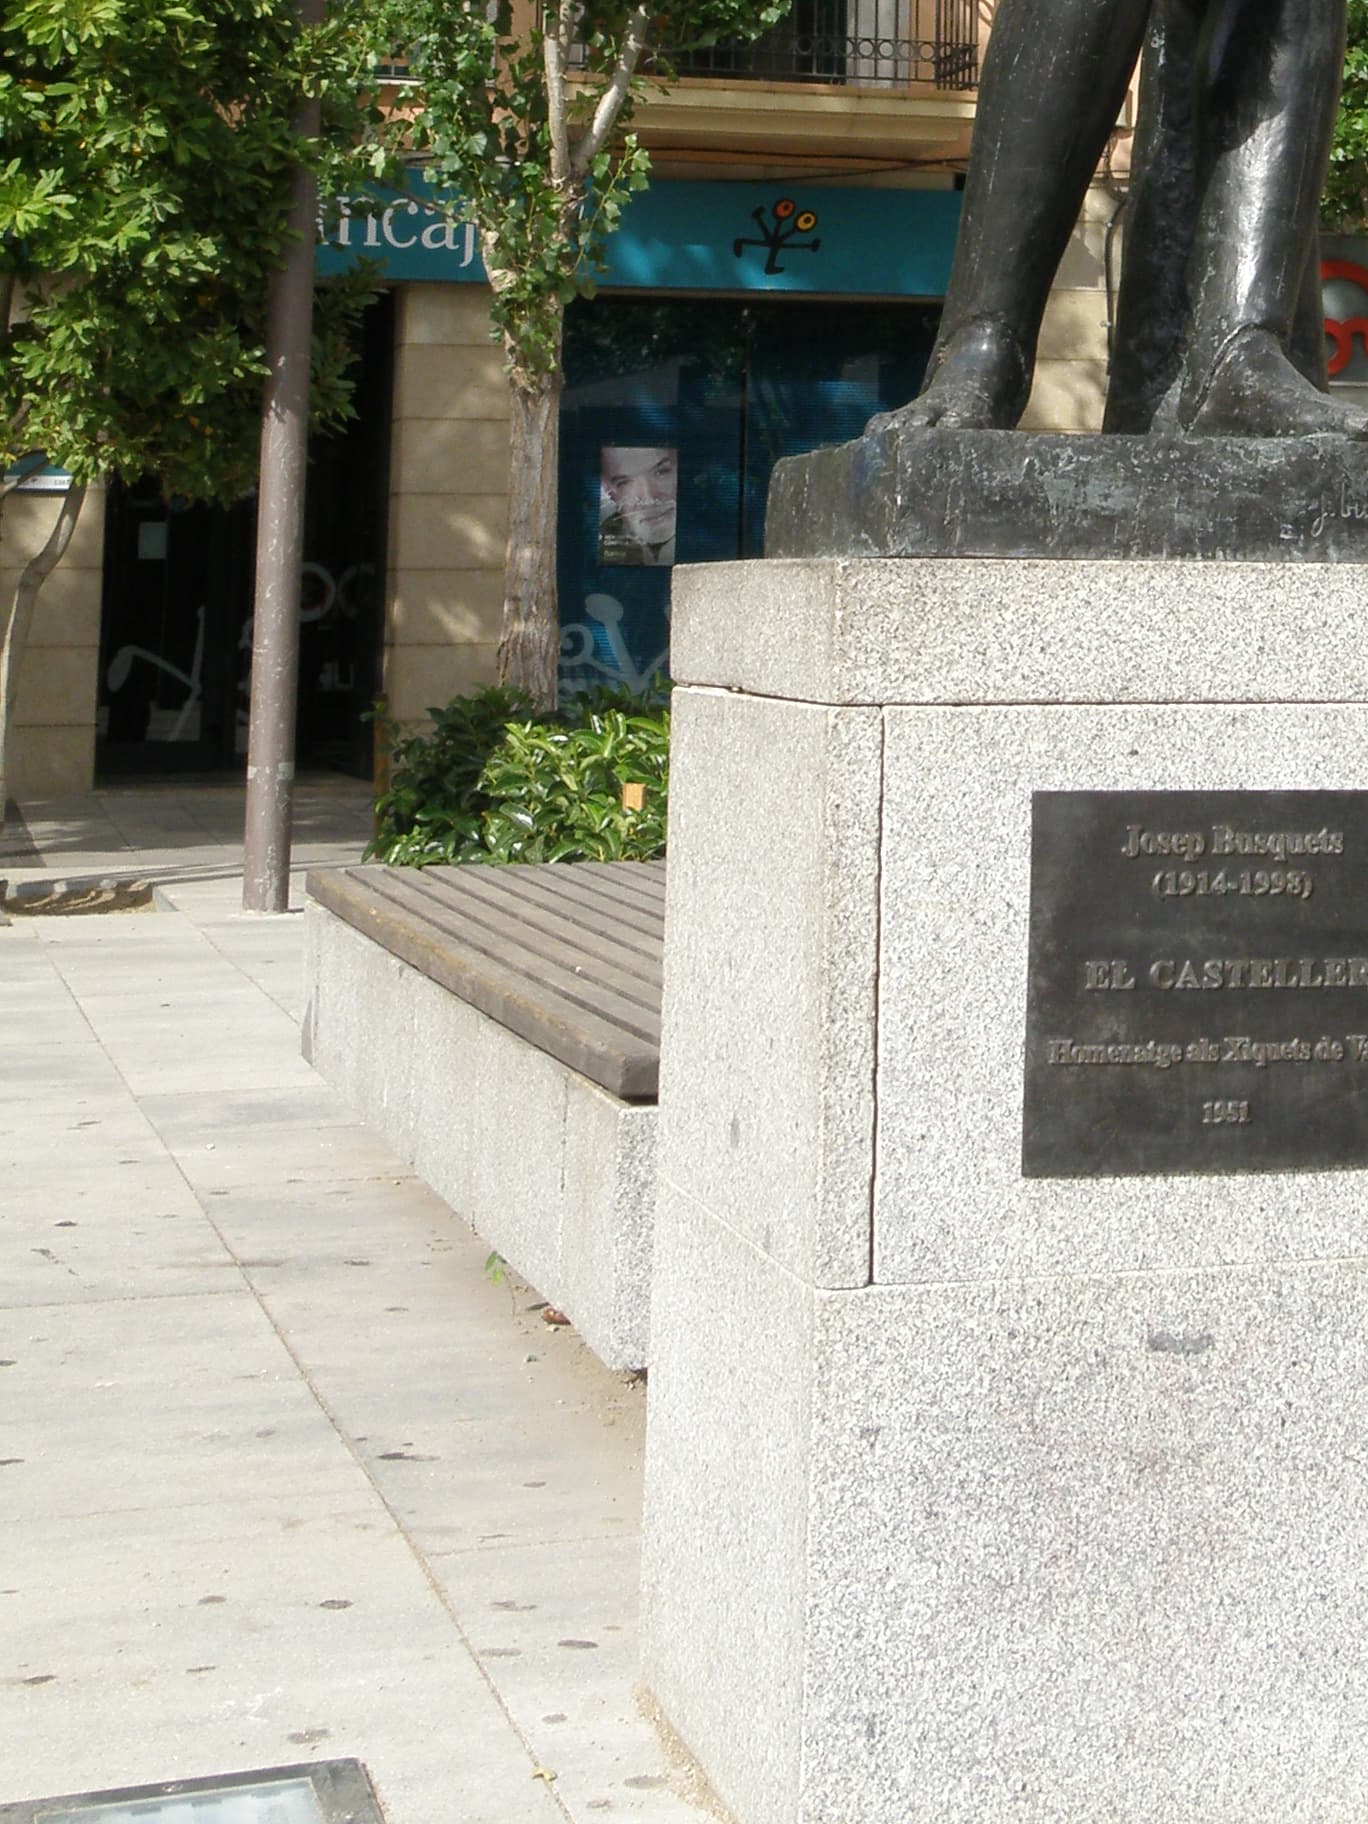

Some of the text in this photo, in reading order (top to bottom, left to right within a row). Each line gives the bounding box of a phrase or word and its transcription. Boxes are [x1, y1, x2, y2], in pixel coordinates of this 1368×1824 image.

[1121, 824, 1345, 863] Josep Busquets
[1151, 870, 1314, 900] (1914-1998)
[1085, 960, 1136, 990] EL
[1048, 1038, 1184, 1068] Homenatge
[1186, 1037, 1220, 1062] als
[1221, 1036, 1312, 1067] Xiquets
[1314, 1035, 1345, 1060] de
[1202, 1100, 1251, 1124] 1951
